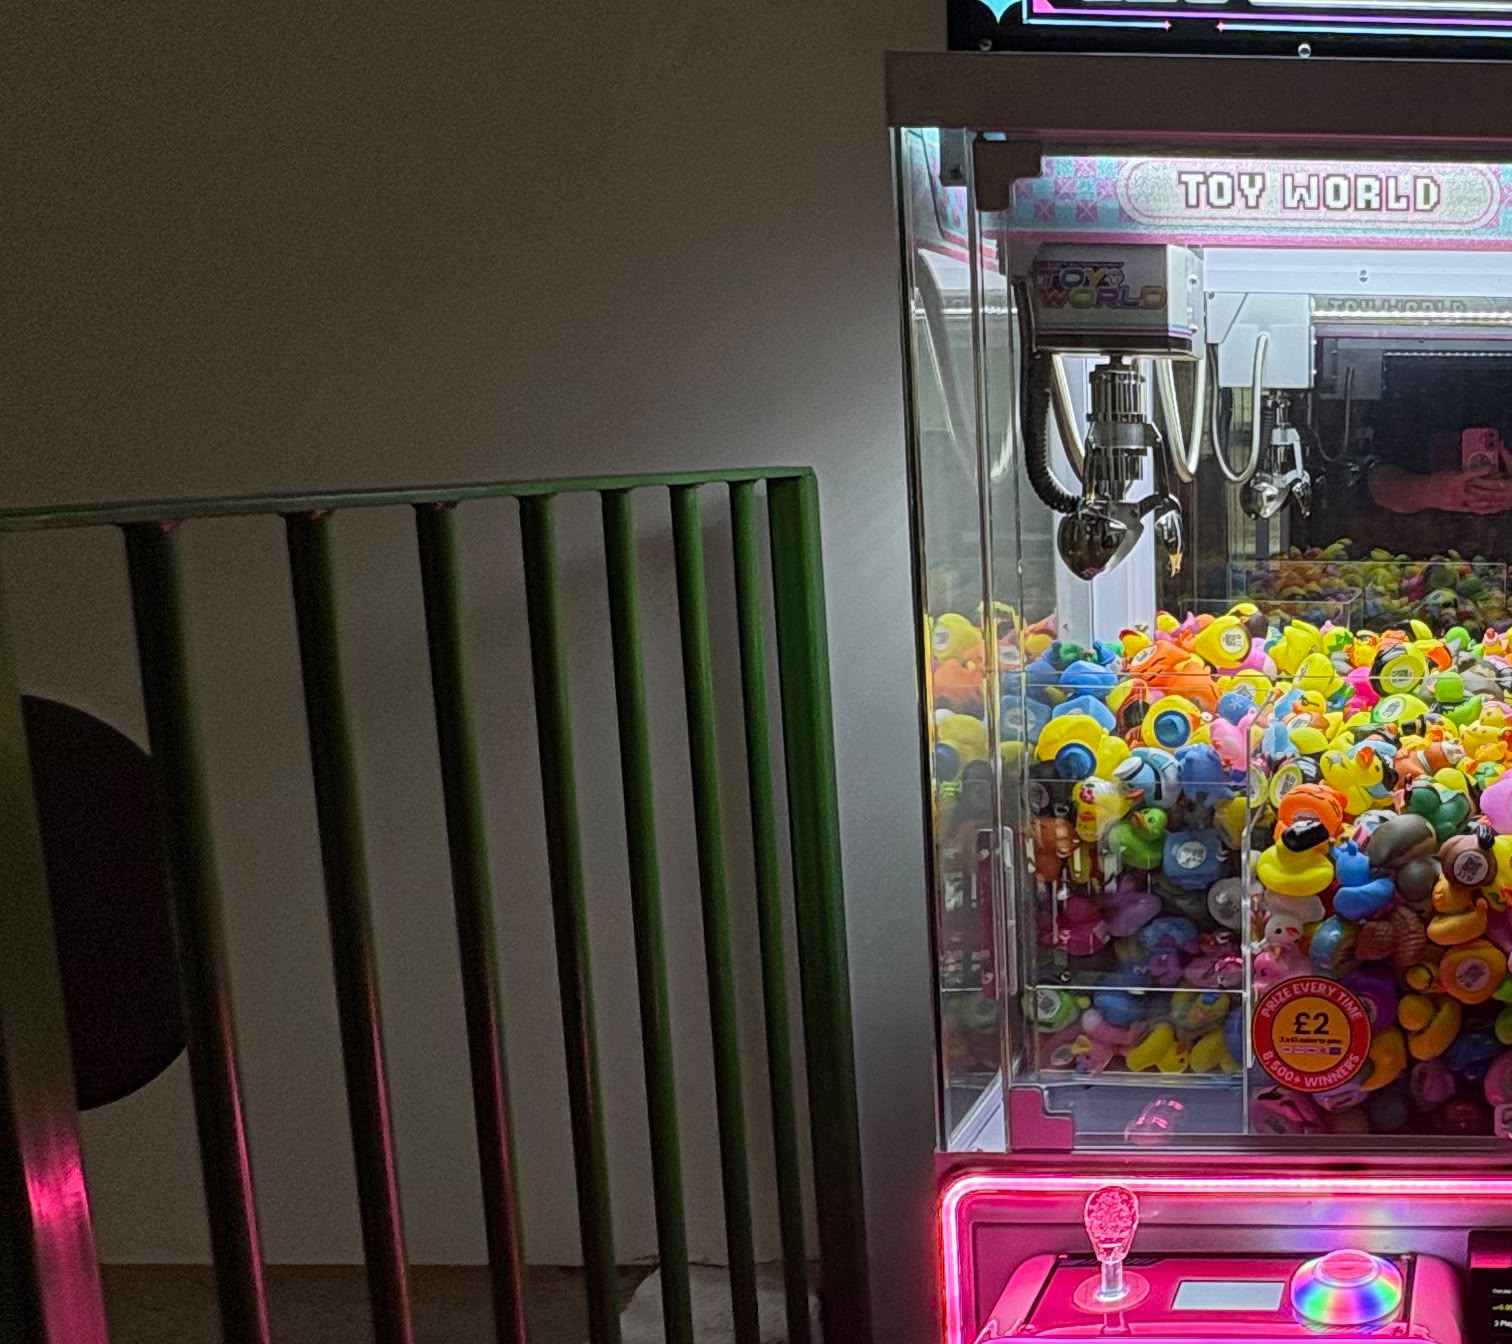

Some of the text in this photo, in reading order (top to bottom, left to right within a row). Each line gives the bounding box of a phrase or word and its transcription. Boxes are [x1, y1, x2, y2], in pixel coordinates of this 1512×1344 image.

[1178, 170, 1441, 213] TOY WORLD
[1261, 981, 1363, 1020] PRIZE EVERY TIME
[1293, 1011, 1330, 1035] £2
[1304, 1052, 1361, 1088] WINNERS
